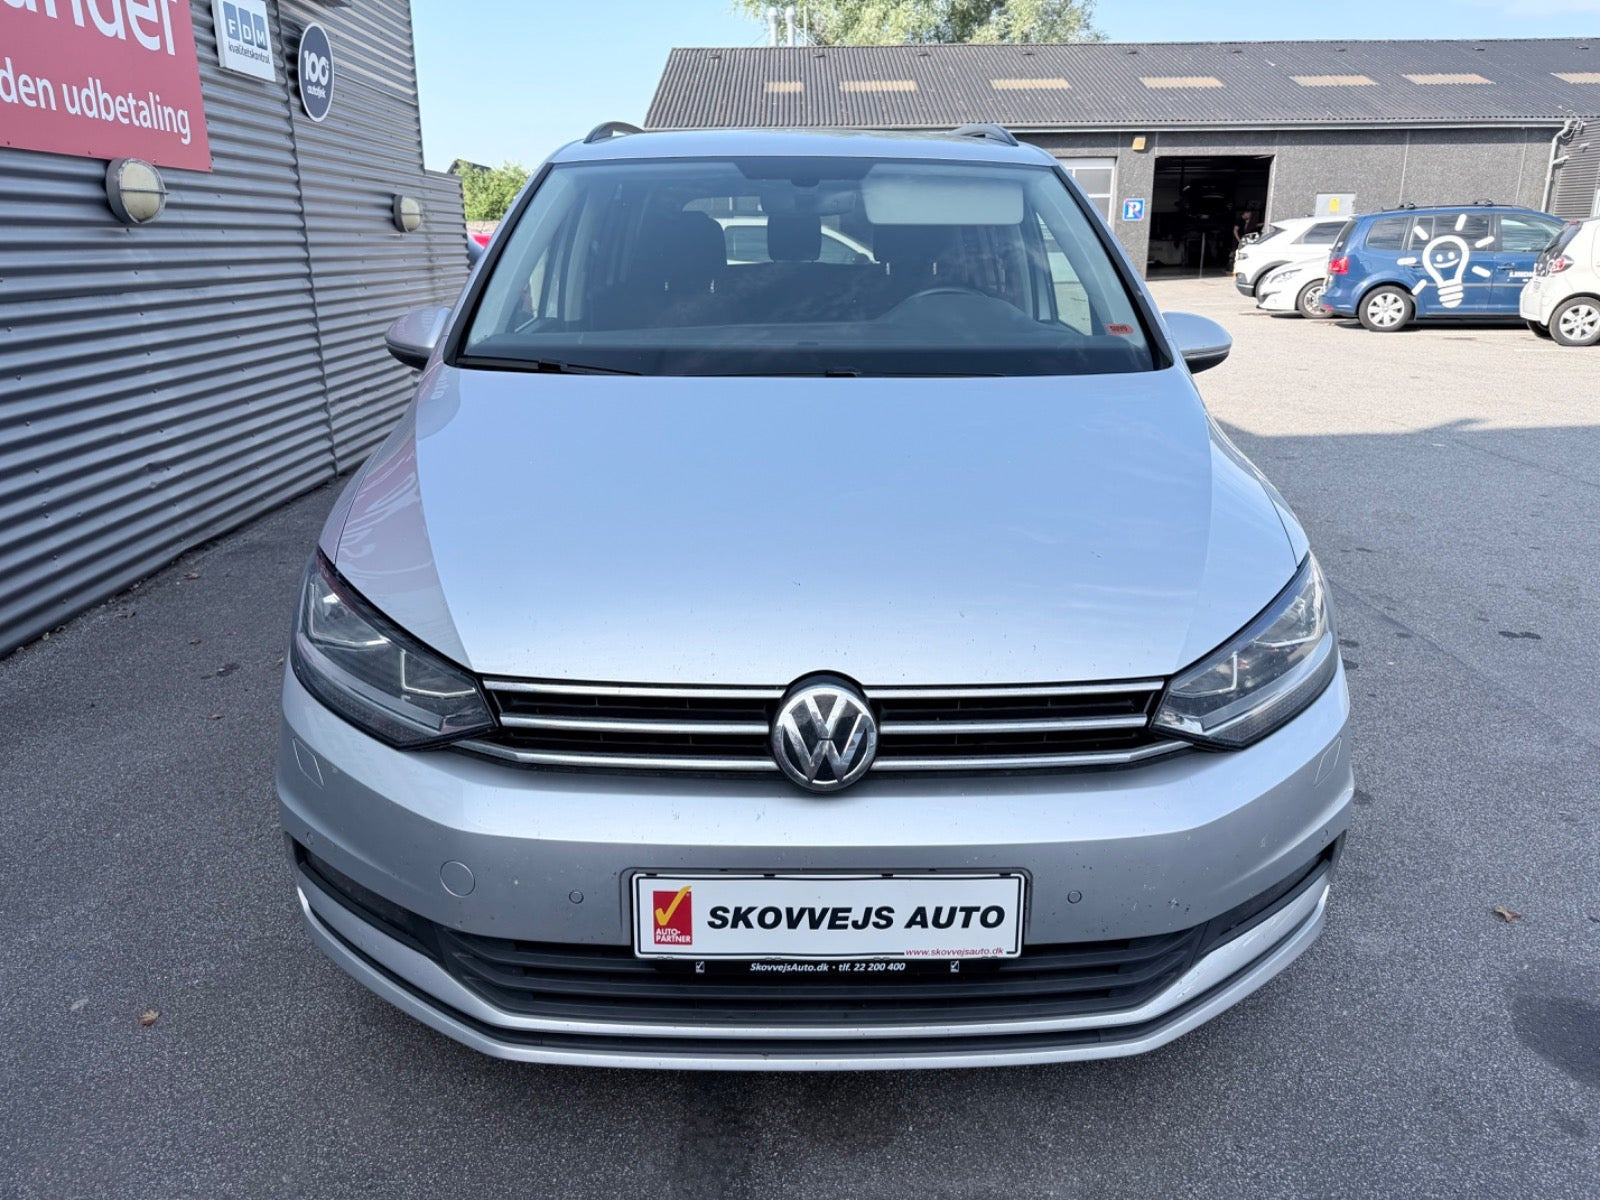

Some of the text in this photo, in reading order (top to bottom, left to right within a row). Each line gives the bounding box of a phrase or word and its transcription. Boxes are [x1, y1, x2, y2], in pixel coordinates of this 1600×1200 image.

[228, 19, 267, 46] FDM
[62, 77, 191, 145] udbetaling
[1126, 201, 1141, 218] P
[777, 690, 872, 785] VW
[706, 905, 1006, 931] SKOVVEJS AUTO
[655, 935, 691, 943] PARTNER
[905, 946, 1004, 957] www.skovvejsauto.dk
[750, 963, 906, 974] SkovvejsAuto.dk tlf. 22 200 400
